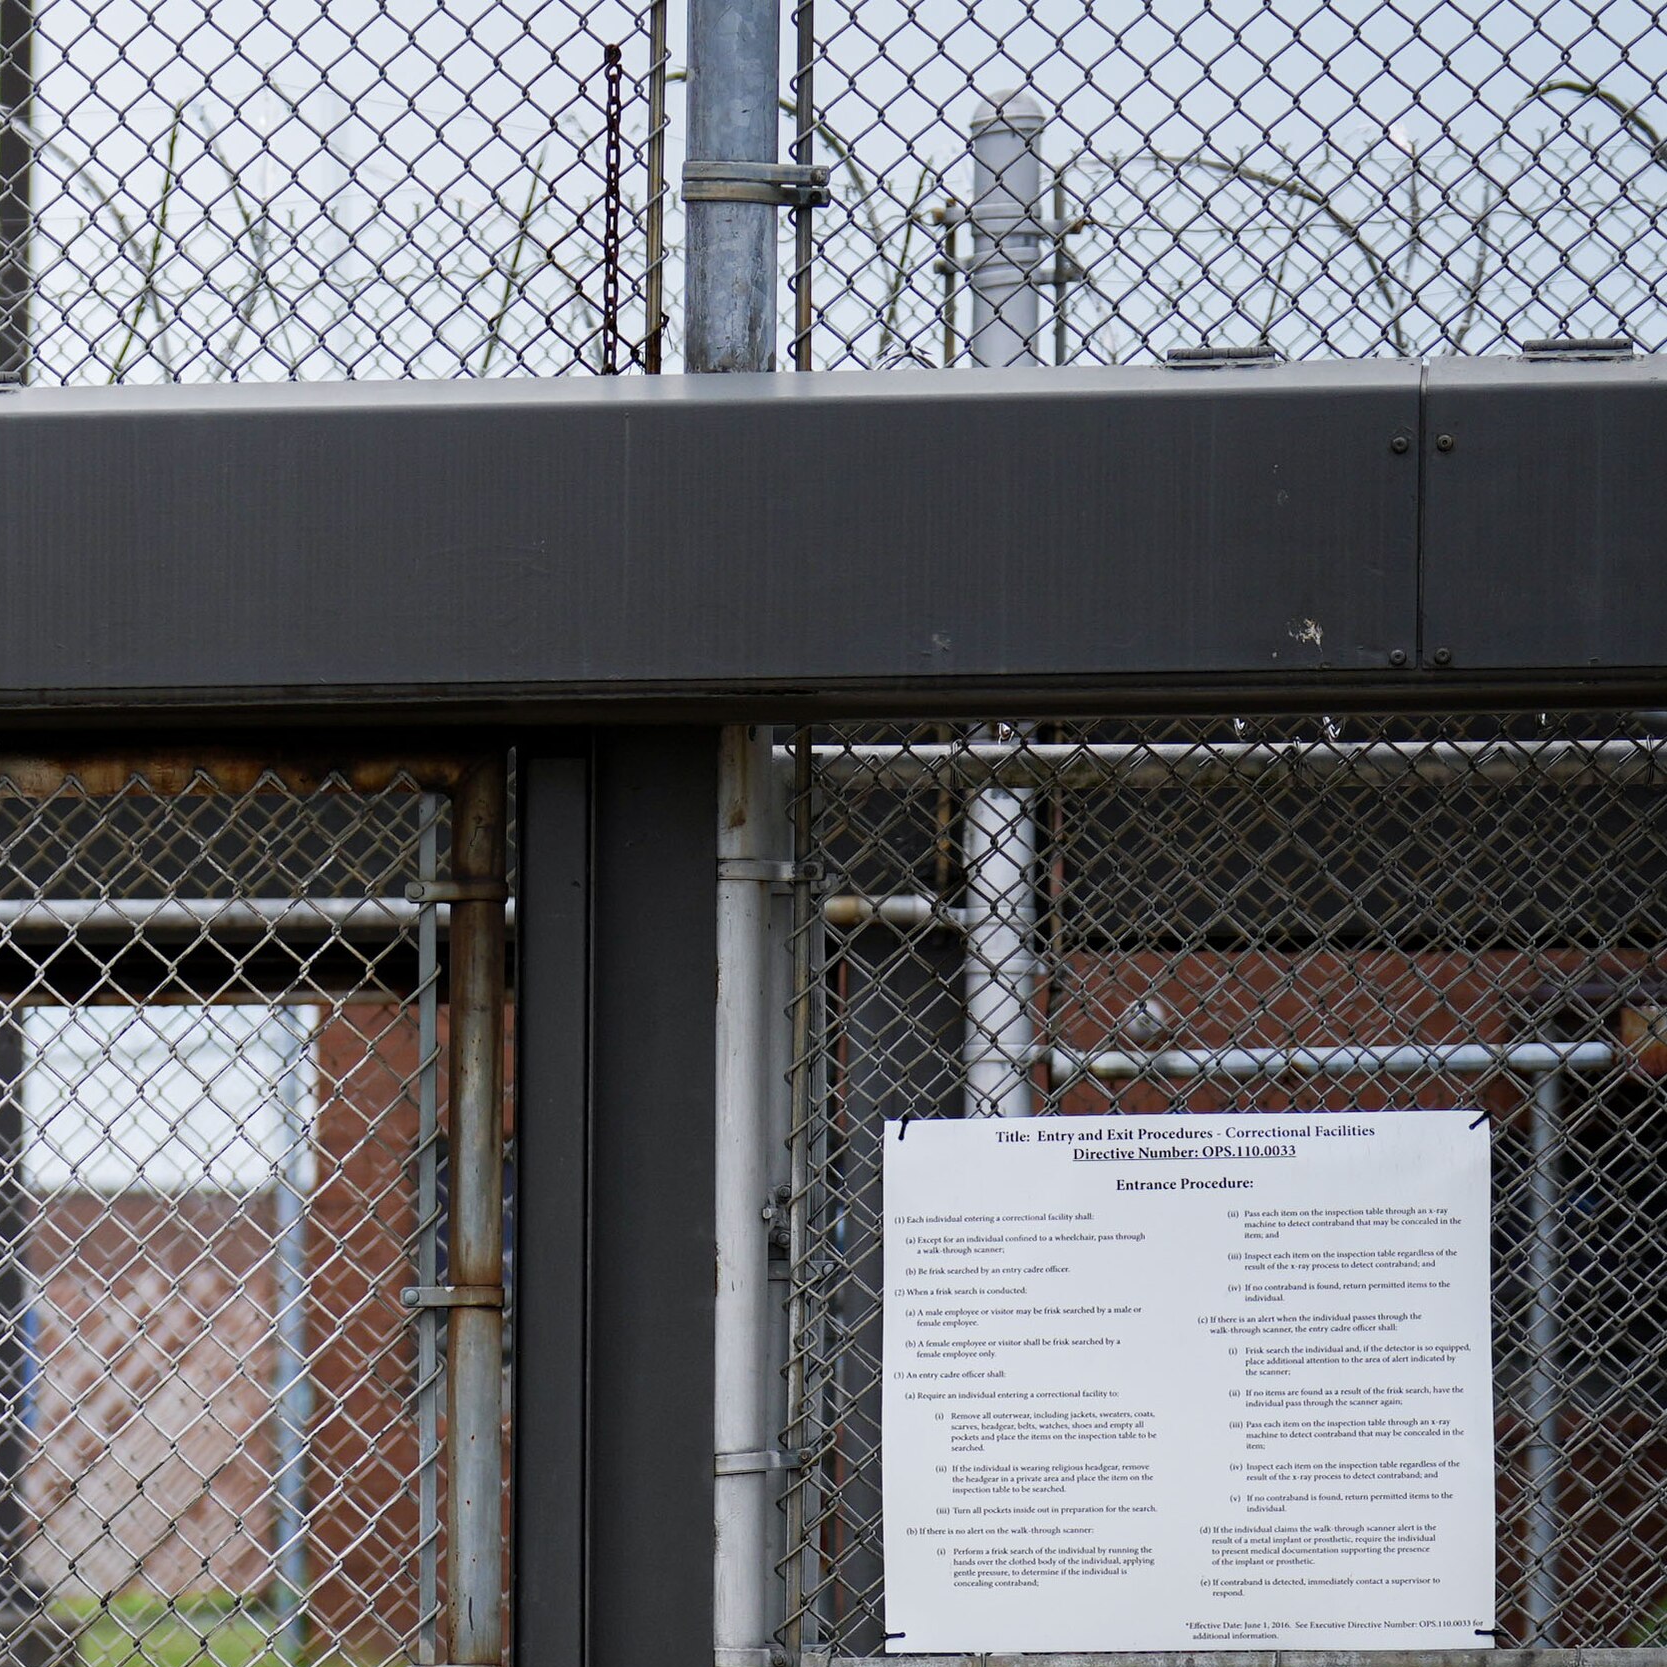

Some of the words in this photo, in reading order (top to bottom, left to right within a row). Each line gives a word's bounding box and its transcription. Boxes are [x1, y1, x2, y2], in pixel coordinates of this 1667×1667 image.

[995, 1131, 1030, 1142] Title:
[1038, 1130, 1075, 1145] Entry
[1078, 1129, 1102, 1141] and
[1107, 1129, 1133, 1140] Exit
[1138, 1127, 1213, 1140] Procedures
[1225, 1125, 1311, 1138] Correctional
[1315, 1125, 1375, 1137] Facilities
[1074, 1148, 1135, 1160] Directive
[1138, 1146, 1198, 1159] Number:
[1202, 1145, 1296, 1159] OPS.110.0033
[1117, 1179, 1177, 1191] Entrance
[1181, 1177, 1253, 1189] Procedure:
